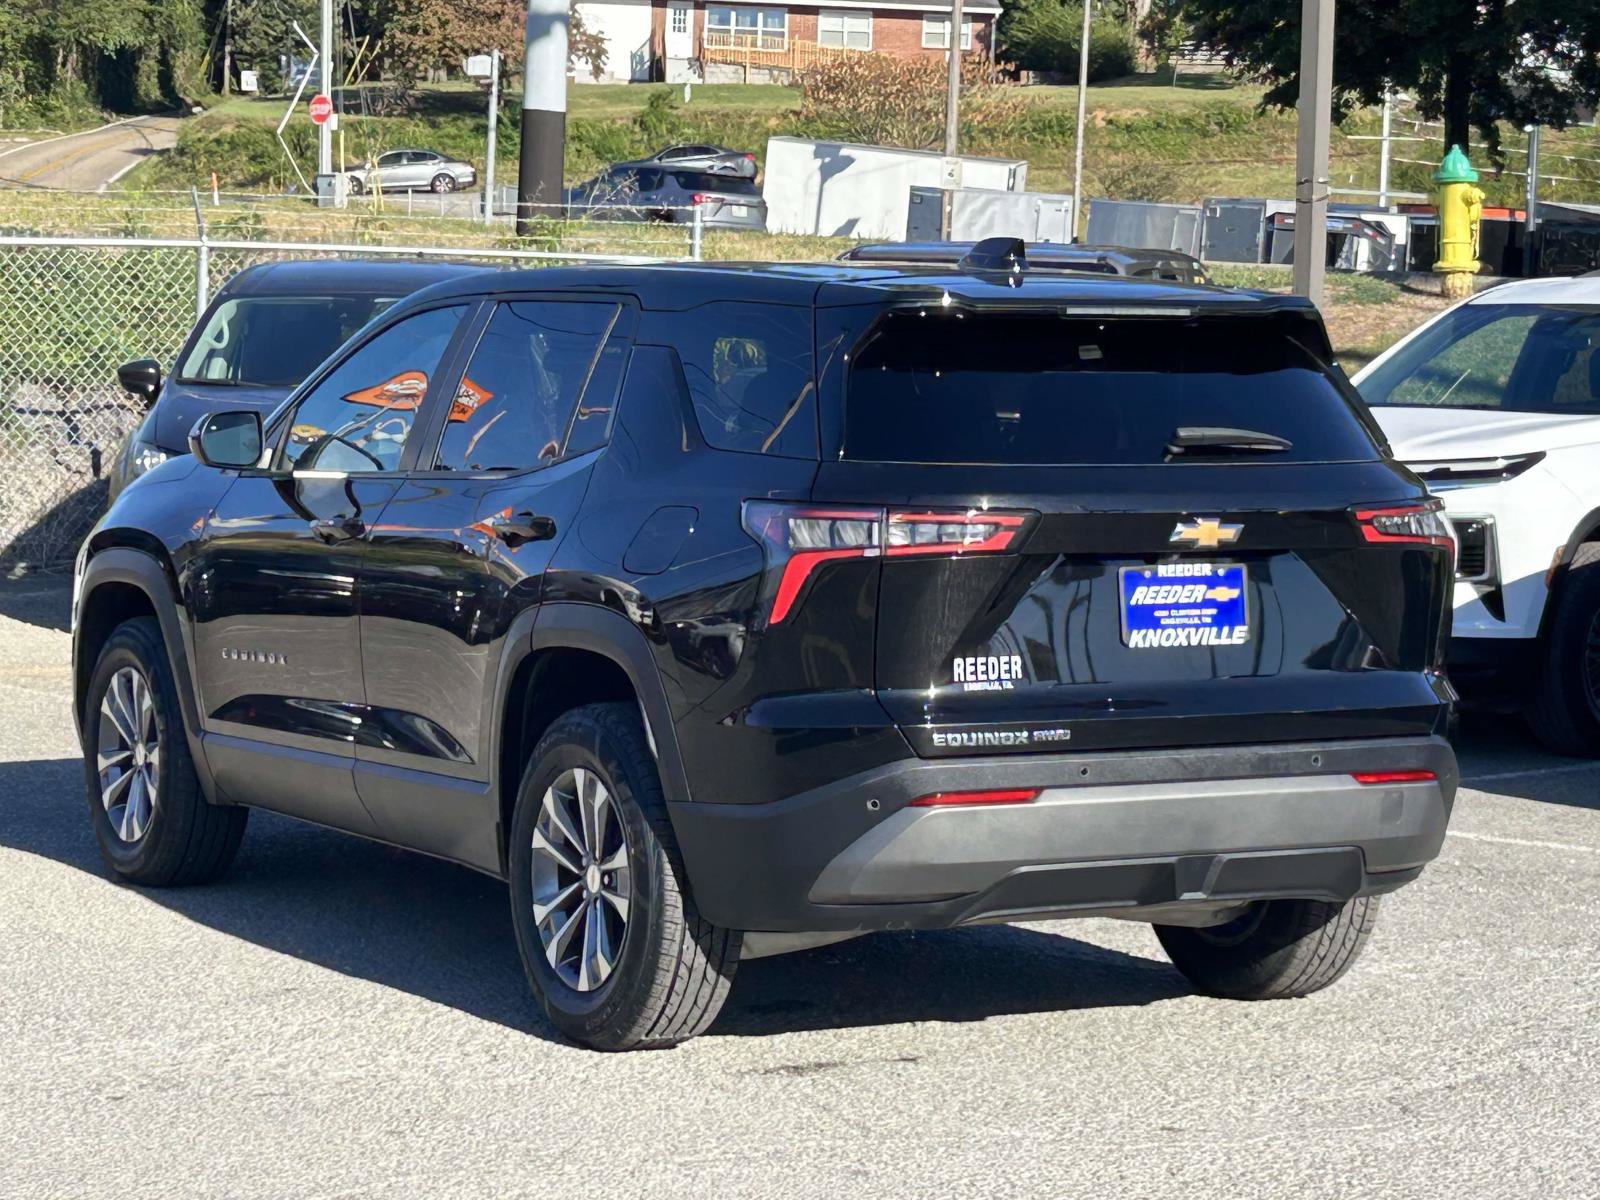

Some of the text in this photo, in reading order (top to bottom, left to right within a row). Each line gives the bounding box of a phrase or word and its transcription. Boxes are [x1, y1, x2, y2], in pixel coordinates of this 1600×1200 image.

[1157, 563, 1213, 578] REEDER
[1130, 584, 1208, 605] REEDER
[1128, 625, 1249, 648] KNOXVILLE
[953, 654, 1023, 682] REEDER
[932, 730, 1030, 747] EQUINOX
